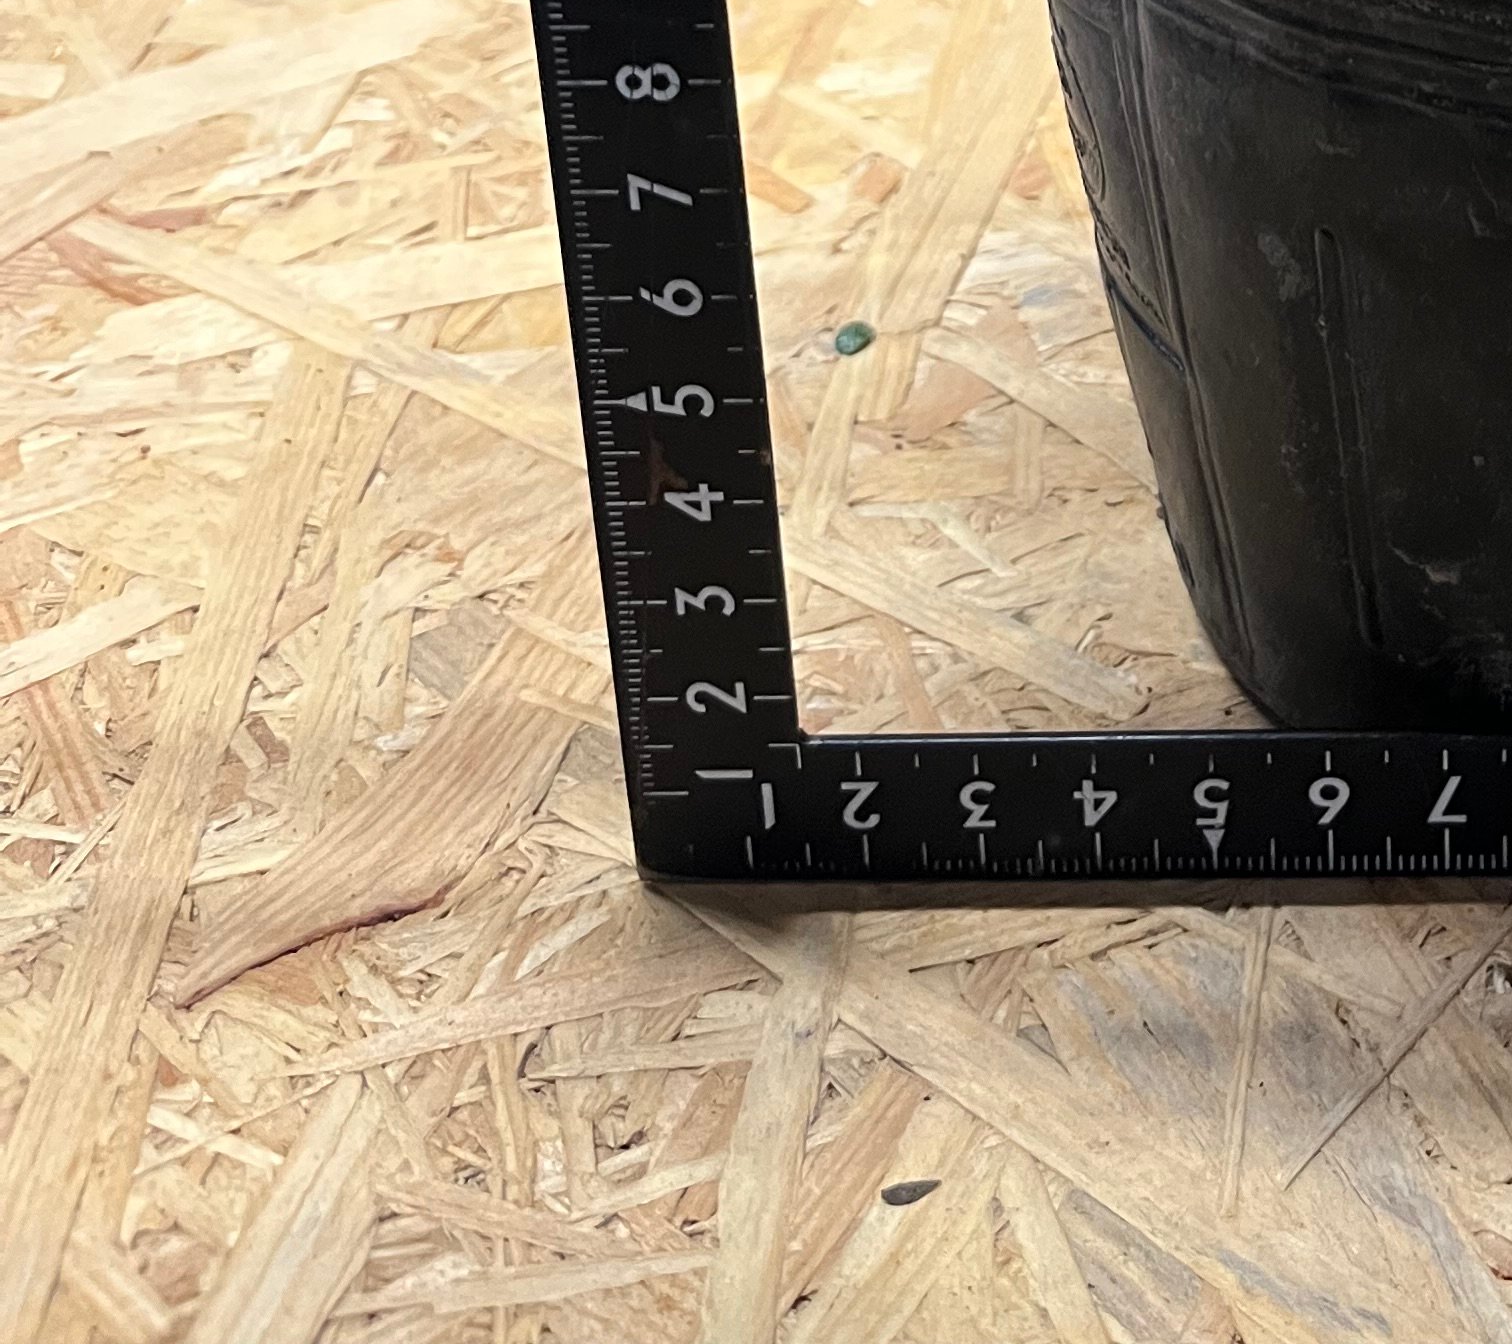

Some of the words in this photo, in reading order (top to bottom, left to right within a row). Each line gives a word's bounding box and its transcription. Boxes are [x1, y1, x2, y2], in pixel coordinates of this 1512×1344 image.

[616, 64, 680, 101] 8
[627, 174, 692, 210] 7
[640, 280, 702, 316] 6
[652, 385, 714, 417] 5
[664, 484, 724, 521] 4
[675, 586, 735, 616] 3
[686, 682, 746, 713] 2
[841, 782, 880, 828] 2
[960, 781, 996, 827] 3
[1074, 780, 1117, 826] 4
[1194, 779, 1229, 826] 5
[1309, 778, 1349, 824] 6
[1428, 776, 1466, 822] 7
